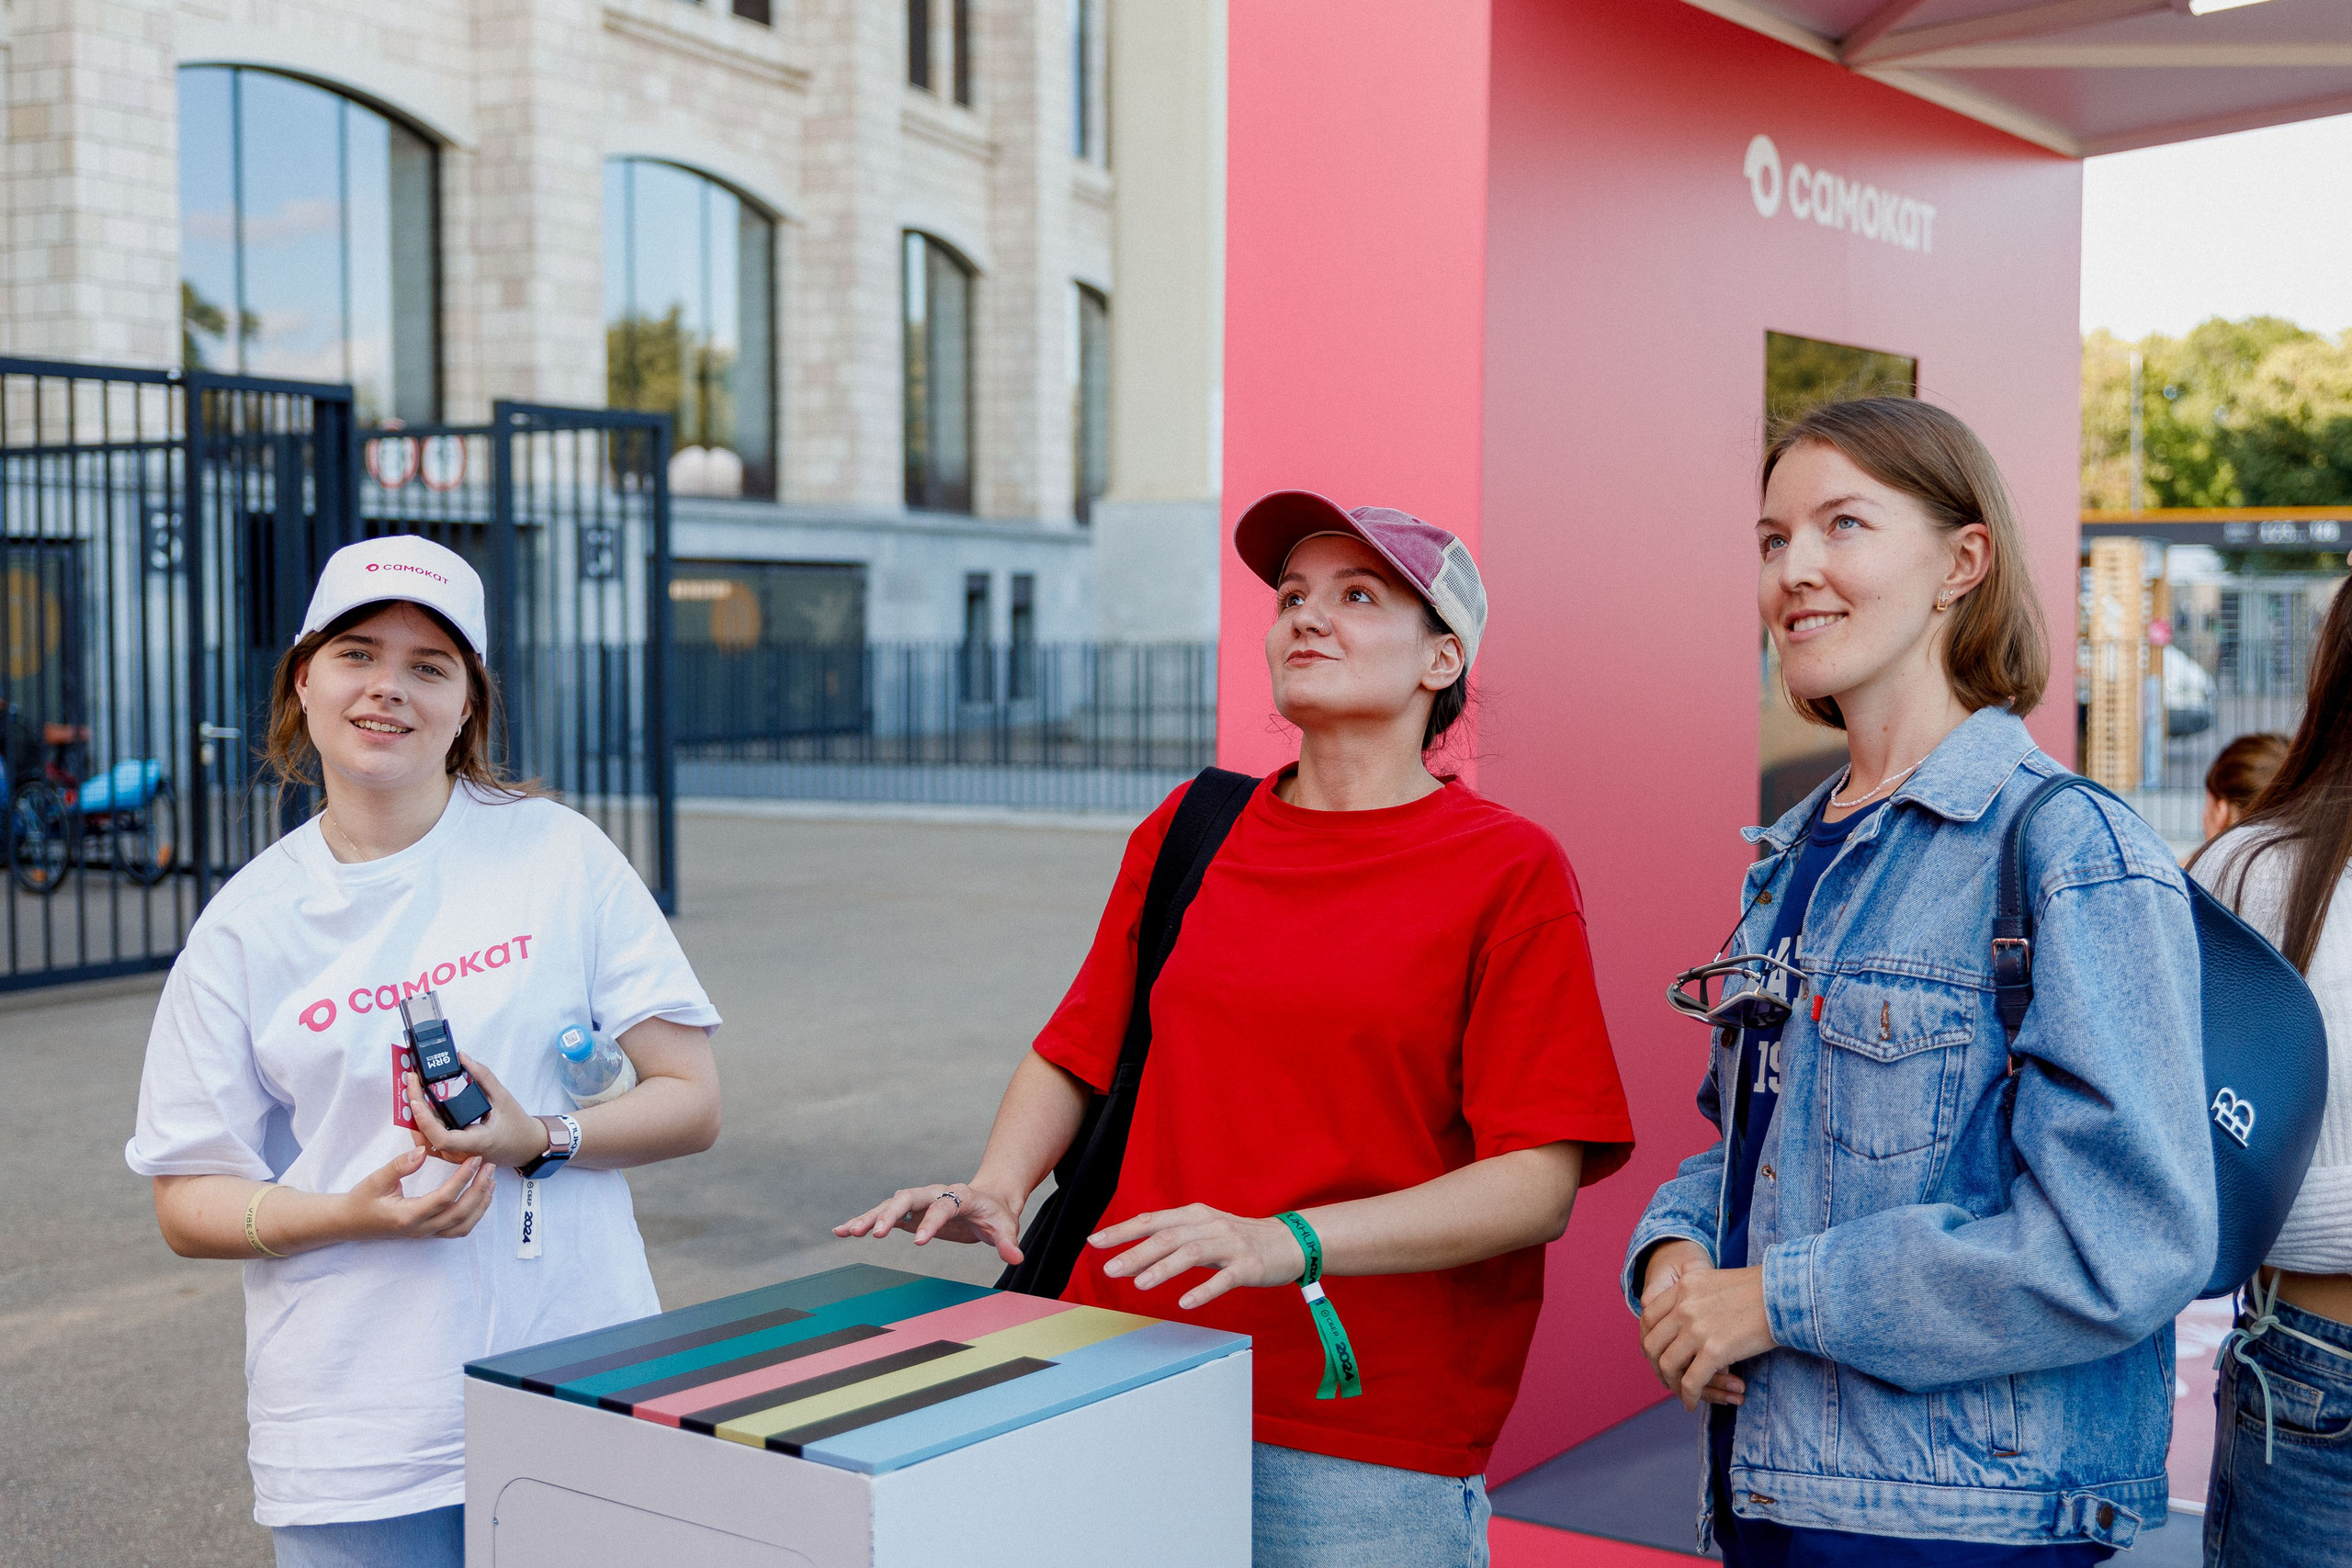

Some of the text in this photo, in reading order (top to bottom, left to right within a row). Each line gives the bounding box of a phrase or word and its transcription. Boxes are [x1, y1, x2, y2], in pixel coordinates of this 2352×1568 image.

[383, 563, 449, 584] самокат
[348, 934, 533, 1014] самокат
[522, 1211, 533, 1244] 2024
[1335, 1341, 1355, 1382] 2024
